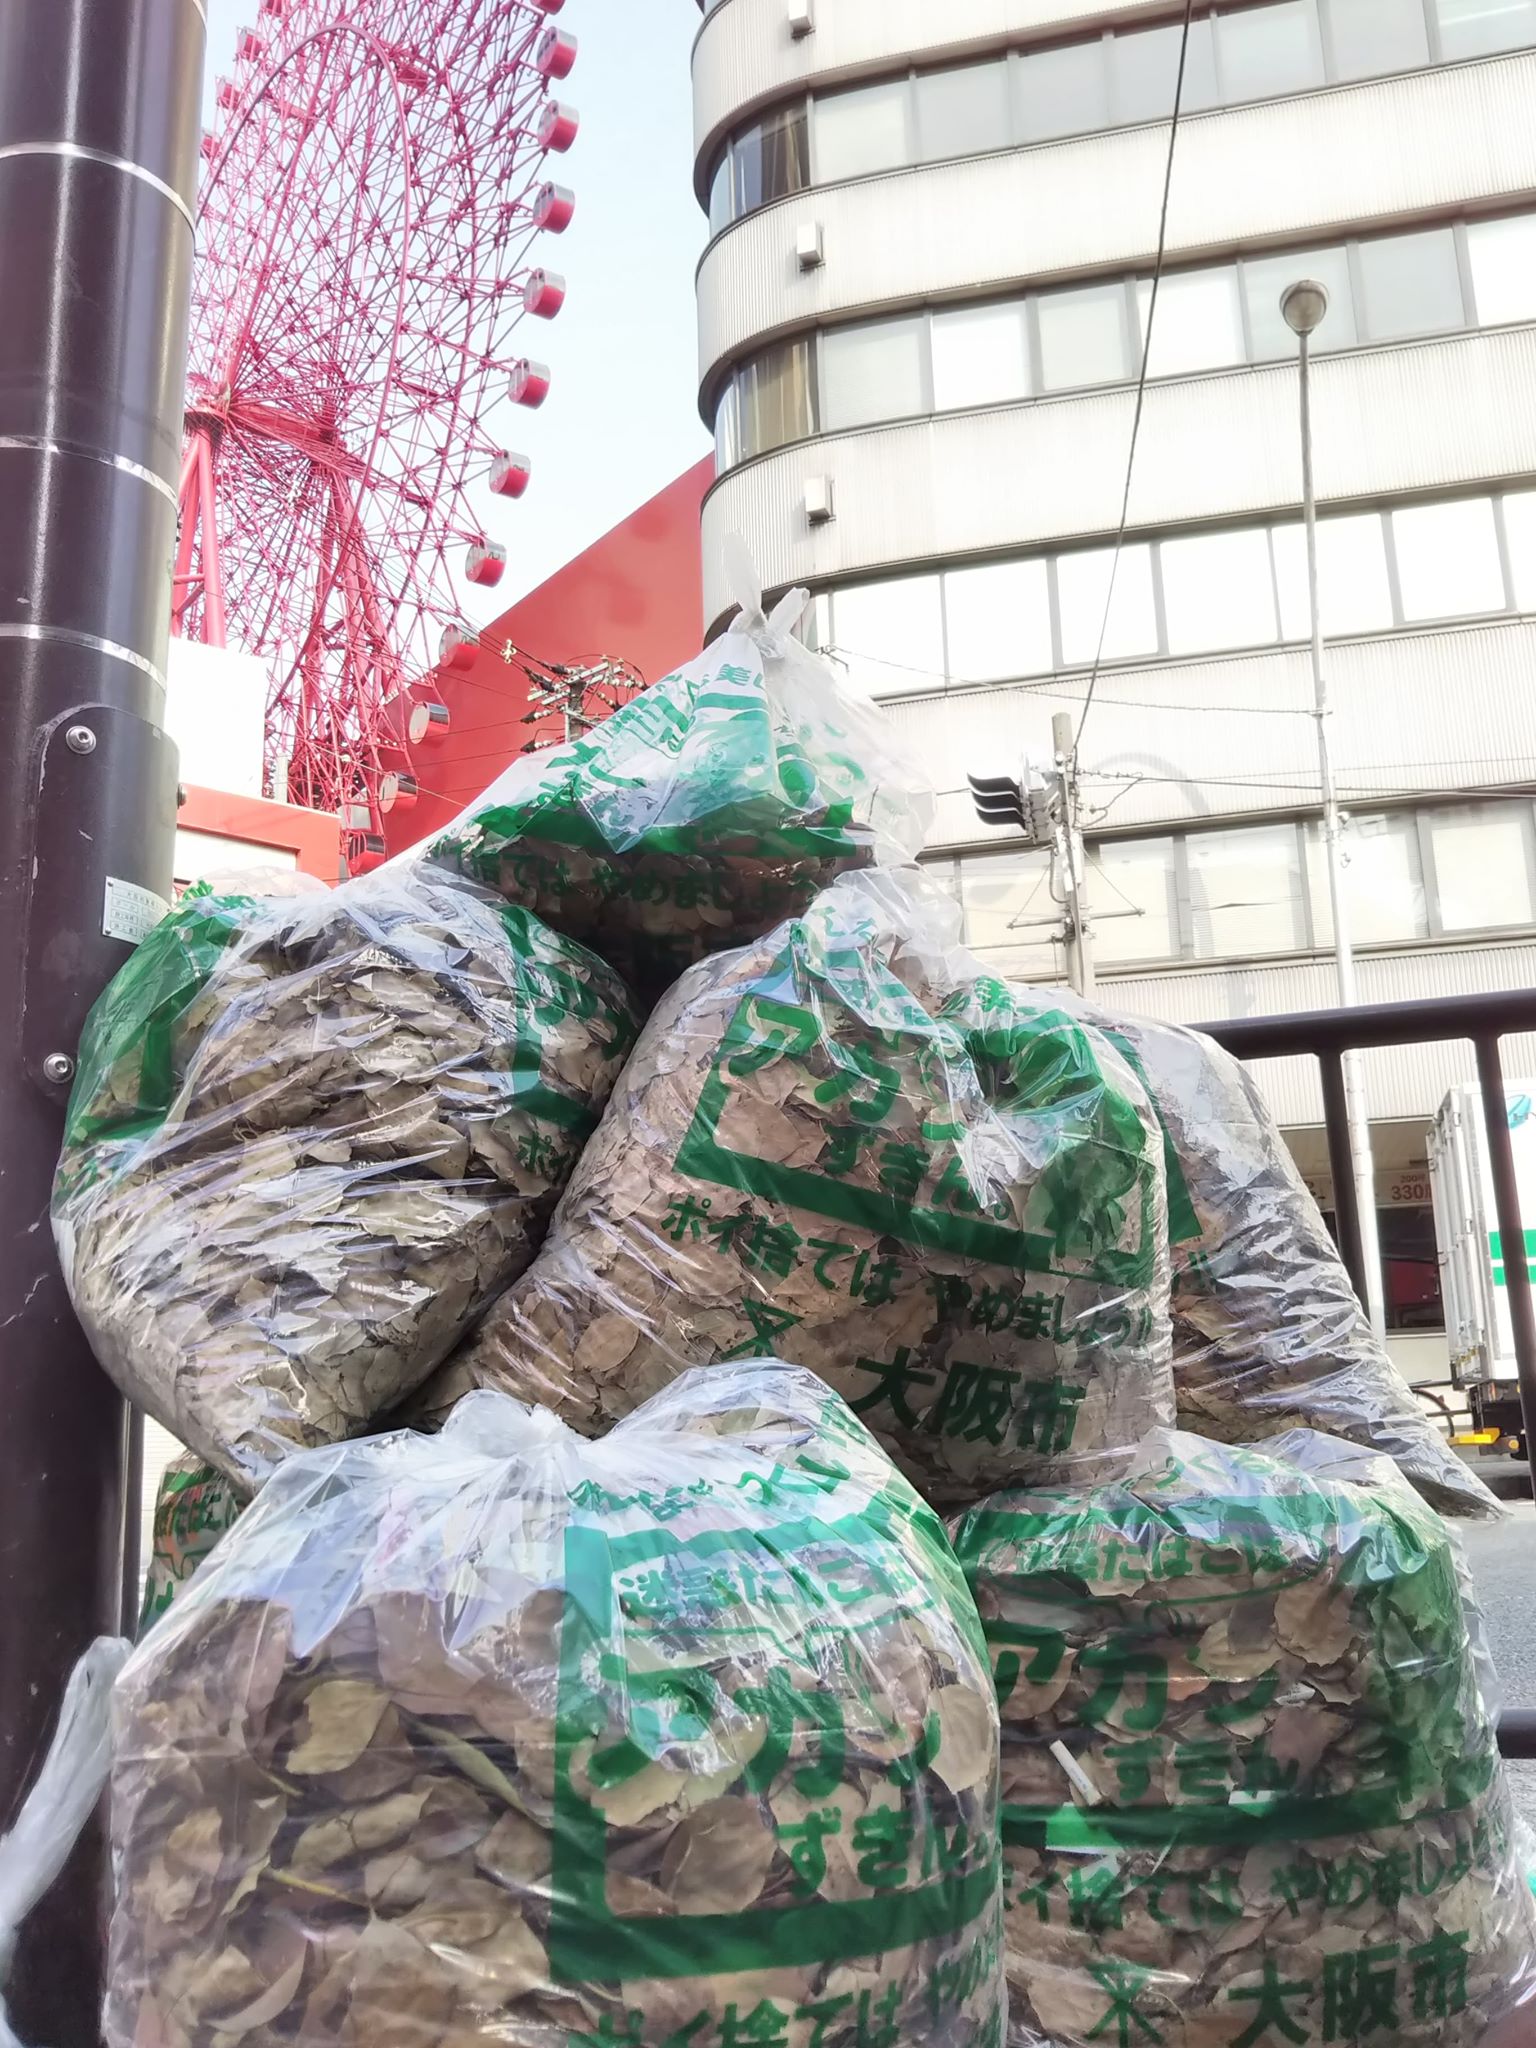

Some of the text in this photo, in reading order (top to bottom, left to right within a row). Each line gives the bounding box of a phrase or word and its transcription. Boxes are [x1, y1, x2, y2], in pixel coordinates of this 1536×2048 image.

[852, 1346, 1087, 1456] 大阪市
[1227, 1930, 1471, 2048] 大阪市
